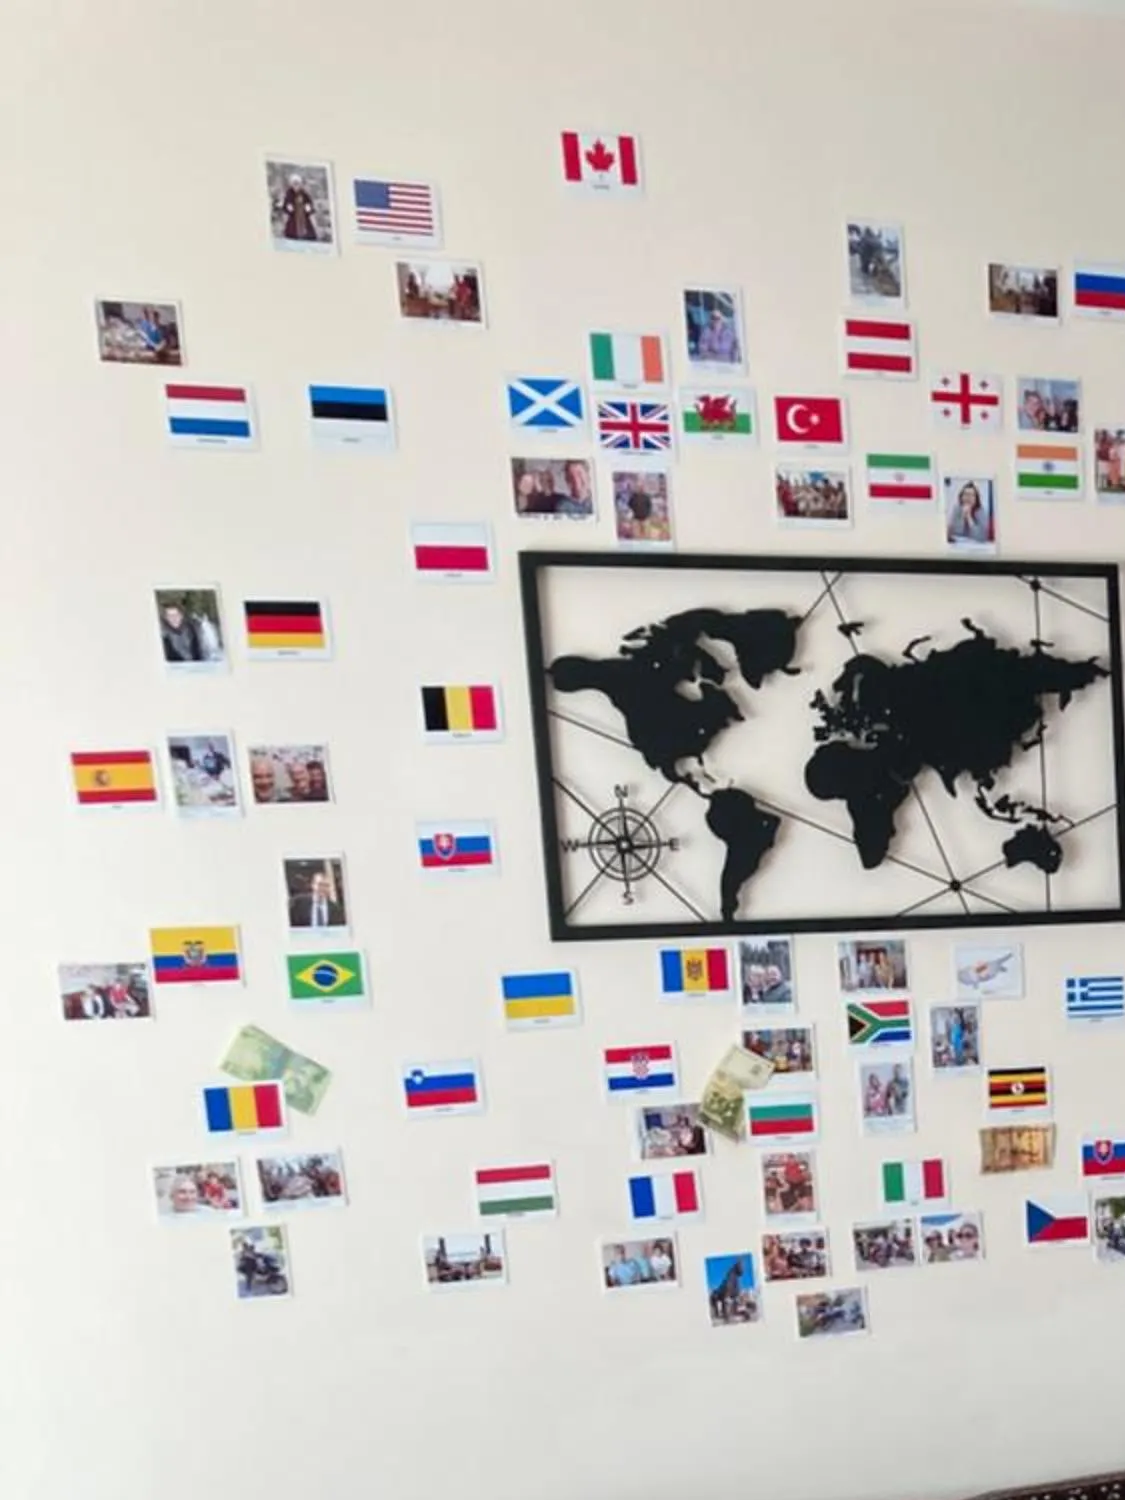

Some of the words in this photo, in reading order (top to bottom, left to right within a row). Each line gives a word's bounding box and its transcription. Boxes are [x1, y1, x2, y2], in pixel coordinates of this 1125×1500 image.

[614, 784, 629, 798] N
[560, 839, 580, 853] W
[667, 837, 680, 852] E
[622, 890, 635, 905] S
